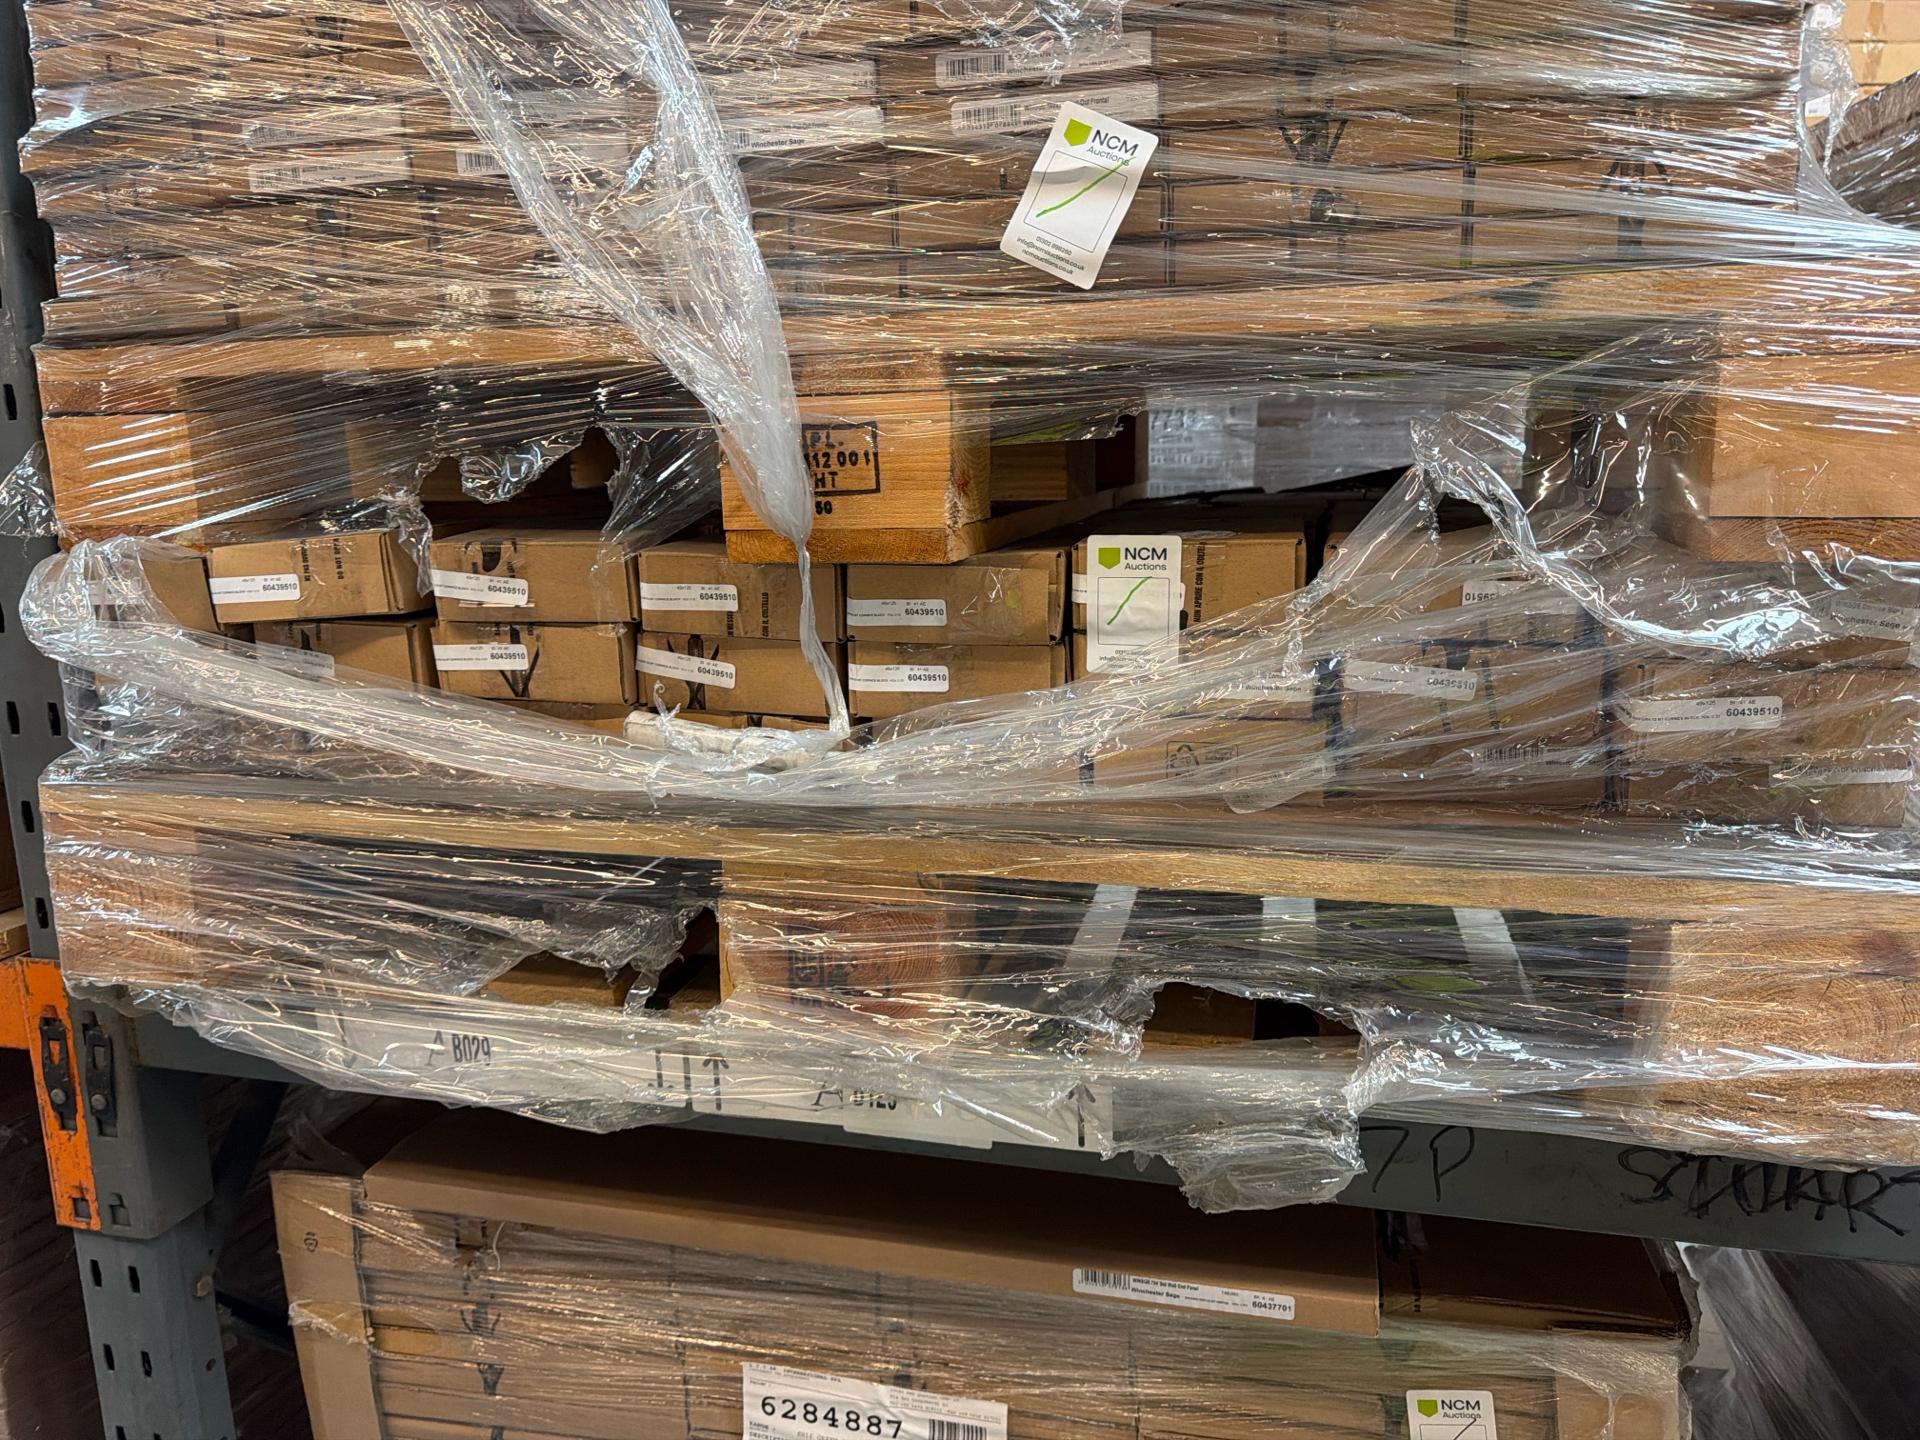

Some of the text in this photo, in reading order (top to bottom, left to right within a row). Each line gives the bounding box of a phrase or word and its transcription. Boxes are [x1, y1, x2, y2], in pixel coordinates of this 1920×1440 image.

[1092, 129, 1139, 156] NCM
[1086, 146, 1130, 166] Auctions
[1124, 547, 1168, 561] NCM
[335, 557, 343, 570] NOT
[1124, 562, 1167, 571] Auctions
[262, 582, 298, 592] 60439510
[487, 585, 527, 596] 60439510
[699, 592, 737, 601] 60439510
[904, 608, 944, 616] 60439510
[489, 652, 526, 660] 60439510
[697, 666, 734, 680] 60439510
[907, 673, 947, 682] 60439510
[1726, 706, 1780, 717] 60439510
[452, 1033, 491, 1066] B029
[1252, 1300, 1292, 1312] 60437701
[1441, 1399, 1481, 1411] NCM
[761, 1395, 902, 1439] 6284887
[1443, 1411, 1482, 1419] Auctions
